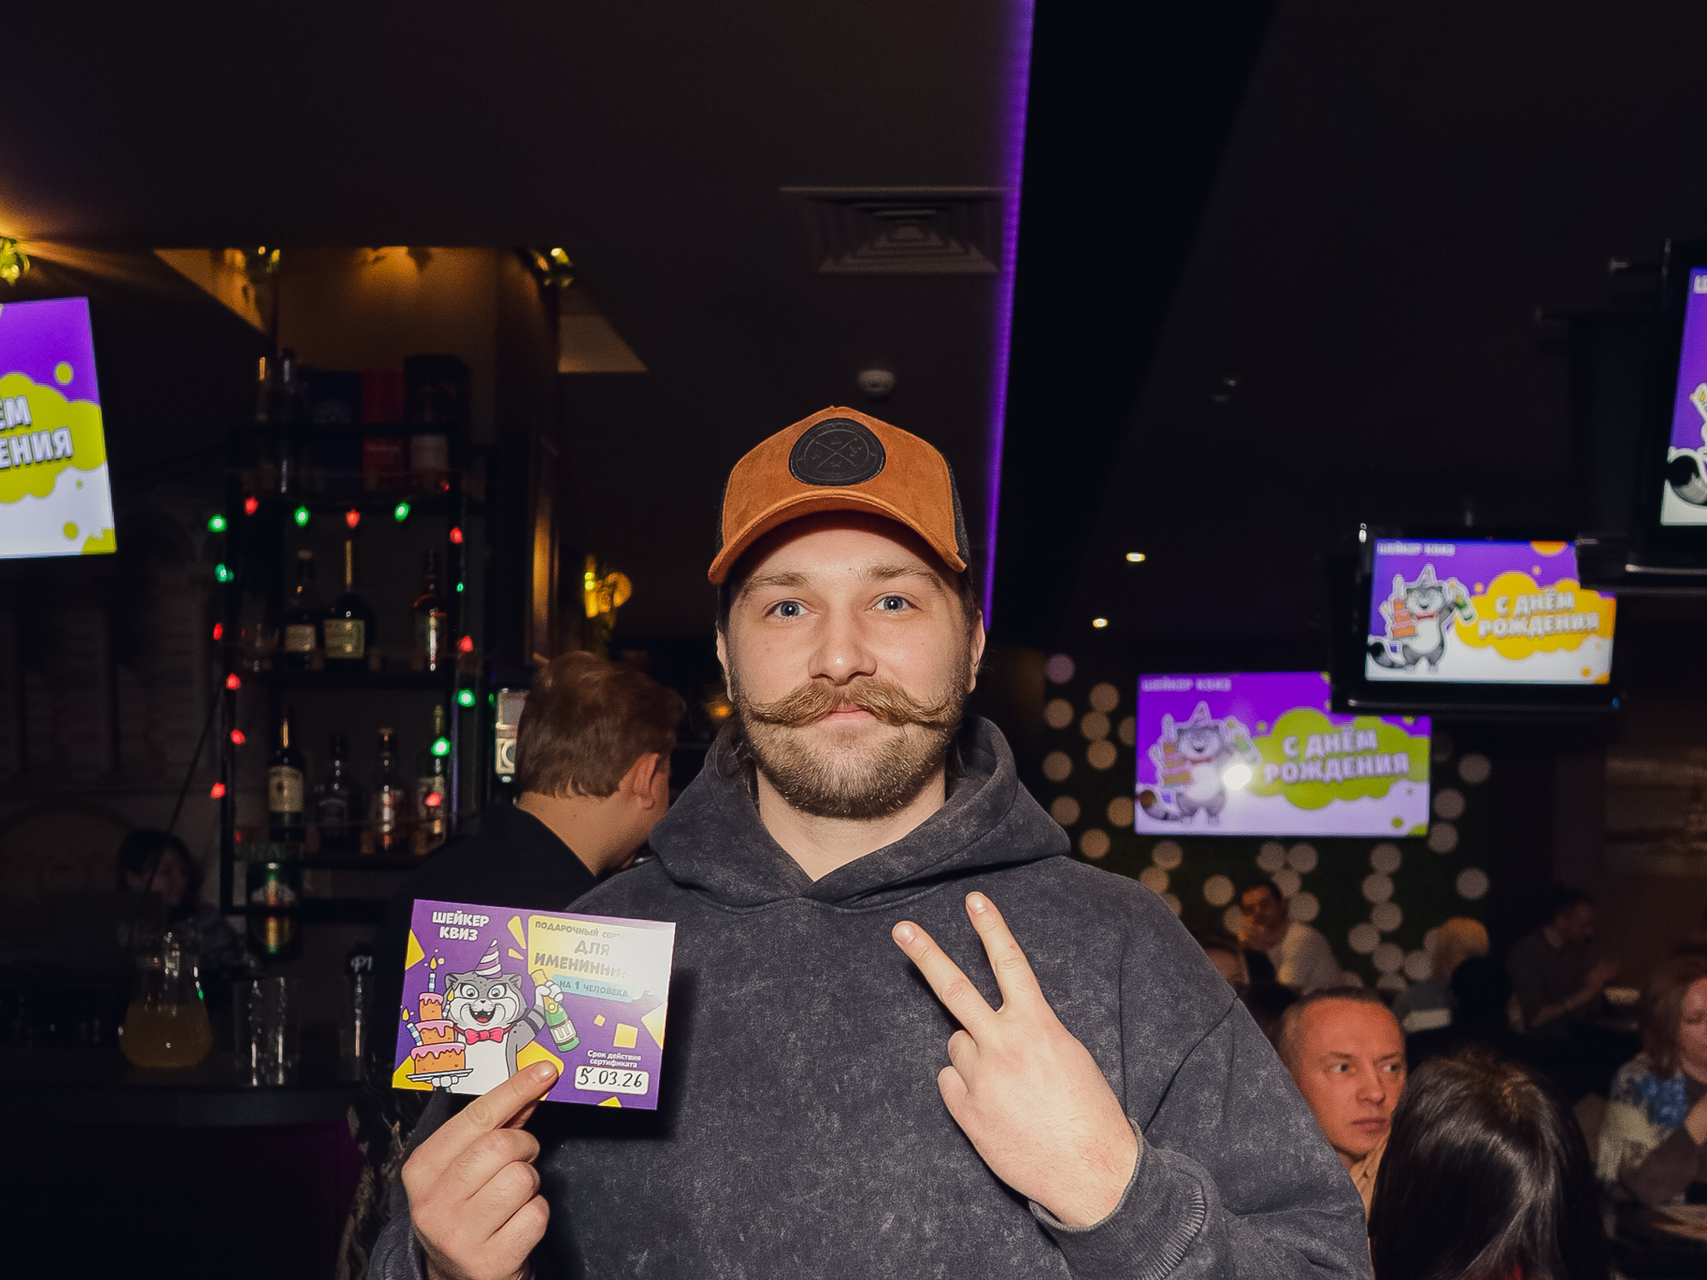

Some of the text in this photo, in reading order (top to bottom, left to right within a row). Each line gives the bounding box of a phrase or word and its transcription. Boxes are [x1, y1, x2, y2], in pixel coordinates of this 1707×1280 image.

[1494, 588, 1575, 618] С ДНЁМ
[1477, 611, 1599, 639] РОЖДЕНИЯ
[1282, 724, 1378, 760] С ДНЁМ
[1264, 752, 1409, 785] РОЖДЕНИЯ
[432, 910, 490, 927] ШЕЙКЕР
[439, 926, 479, 941] КВИЗ
[535, 920, 599, 938] ПОДАРОЧНЫЙ
[574, 940, 611, 957] ДЛЯ
[559, 980, 629, 998] НА 1 ЧЕЛОВЕКА
[587, 1050, 641, 1061] Срок действия
[590, 1058, 637, 1068] сертификата
[577, 1067, 642, 1088] 5.03.26
